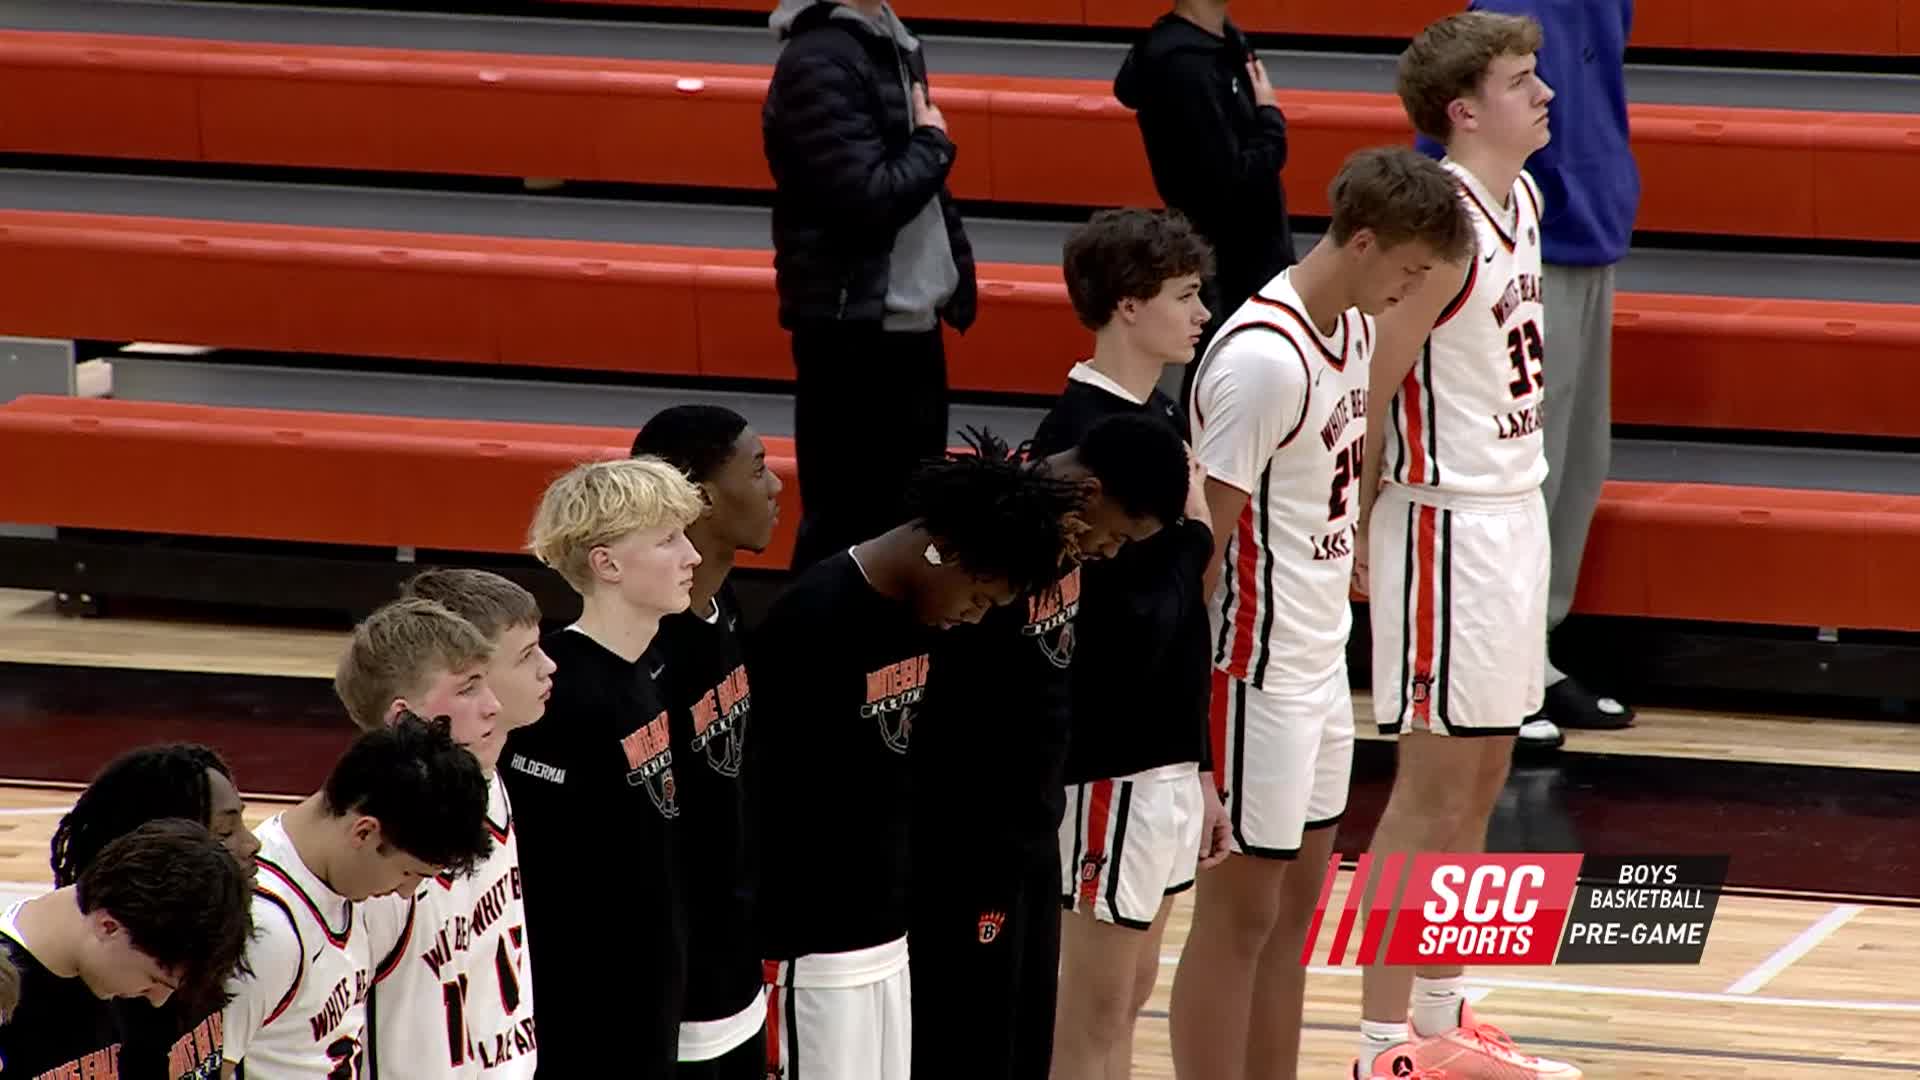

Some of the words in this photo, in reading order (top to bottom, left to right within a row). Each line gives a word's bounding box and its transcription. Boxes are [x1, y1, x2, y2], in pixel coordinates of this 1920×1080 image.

[1320, 395, 1350, 452] WHITE
[1311, 528, 1350, 560] LAKE
[471, 877, 508, 937] WHIT
[310, 977, 350, 1042] WHITE
